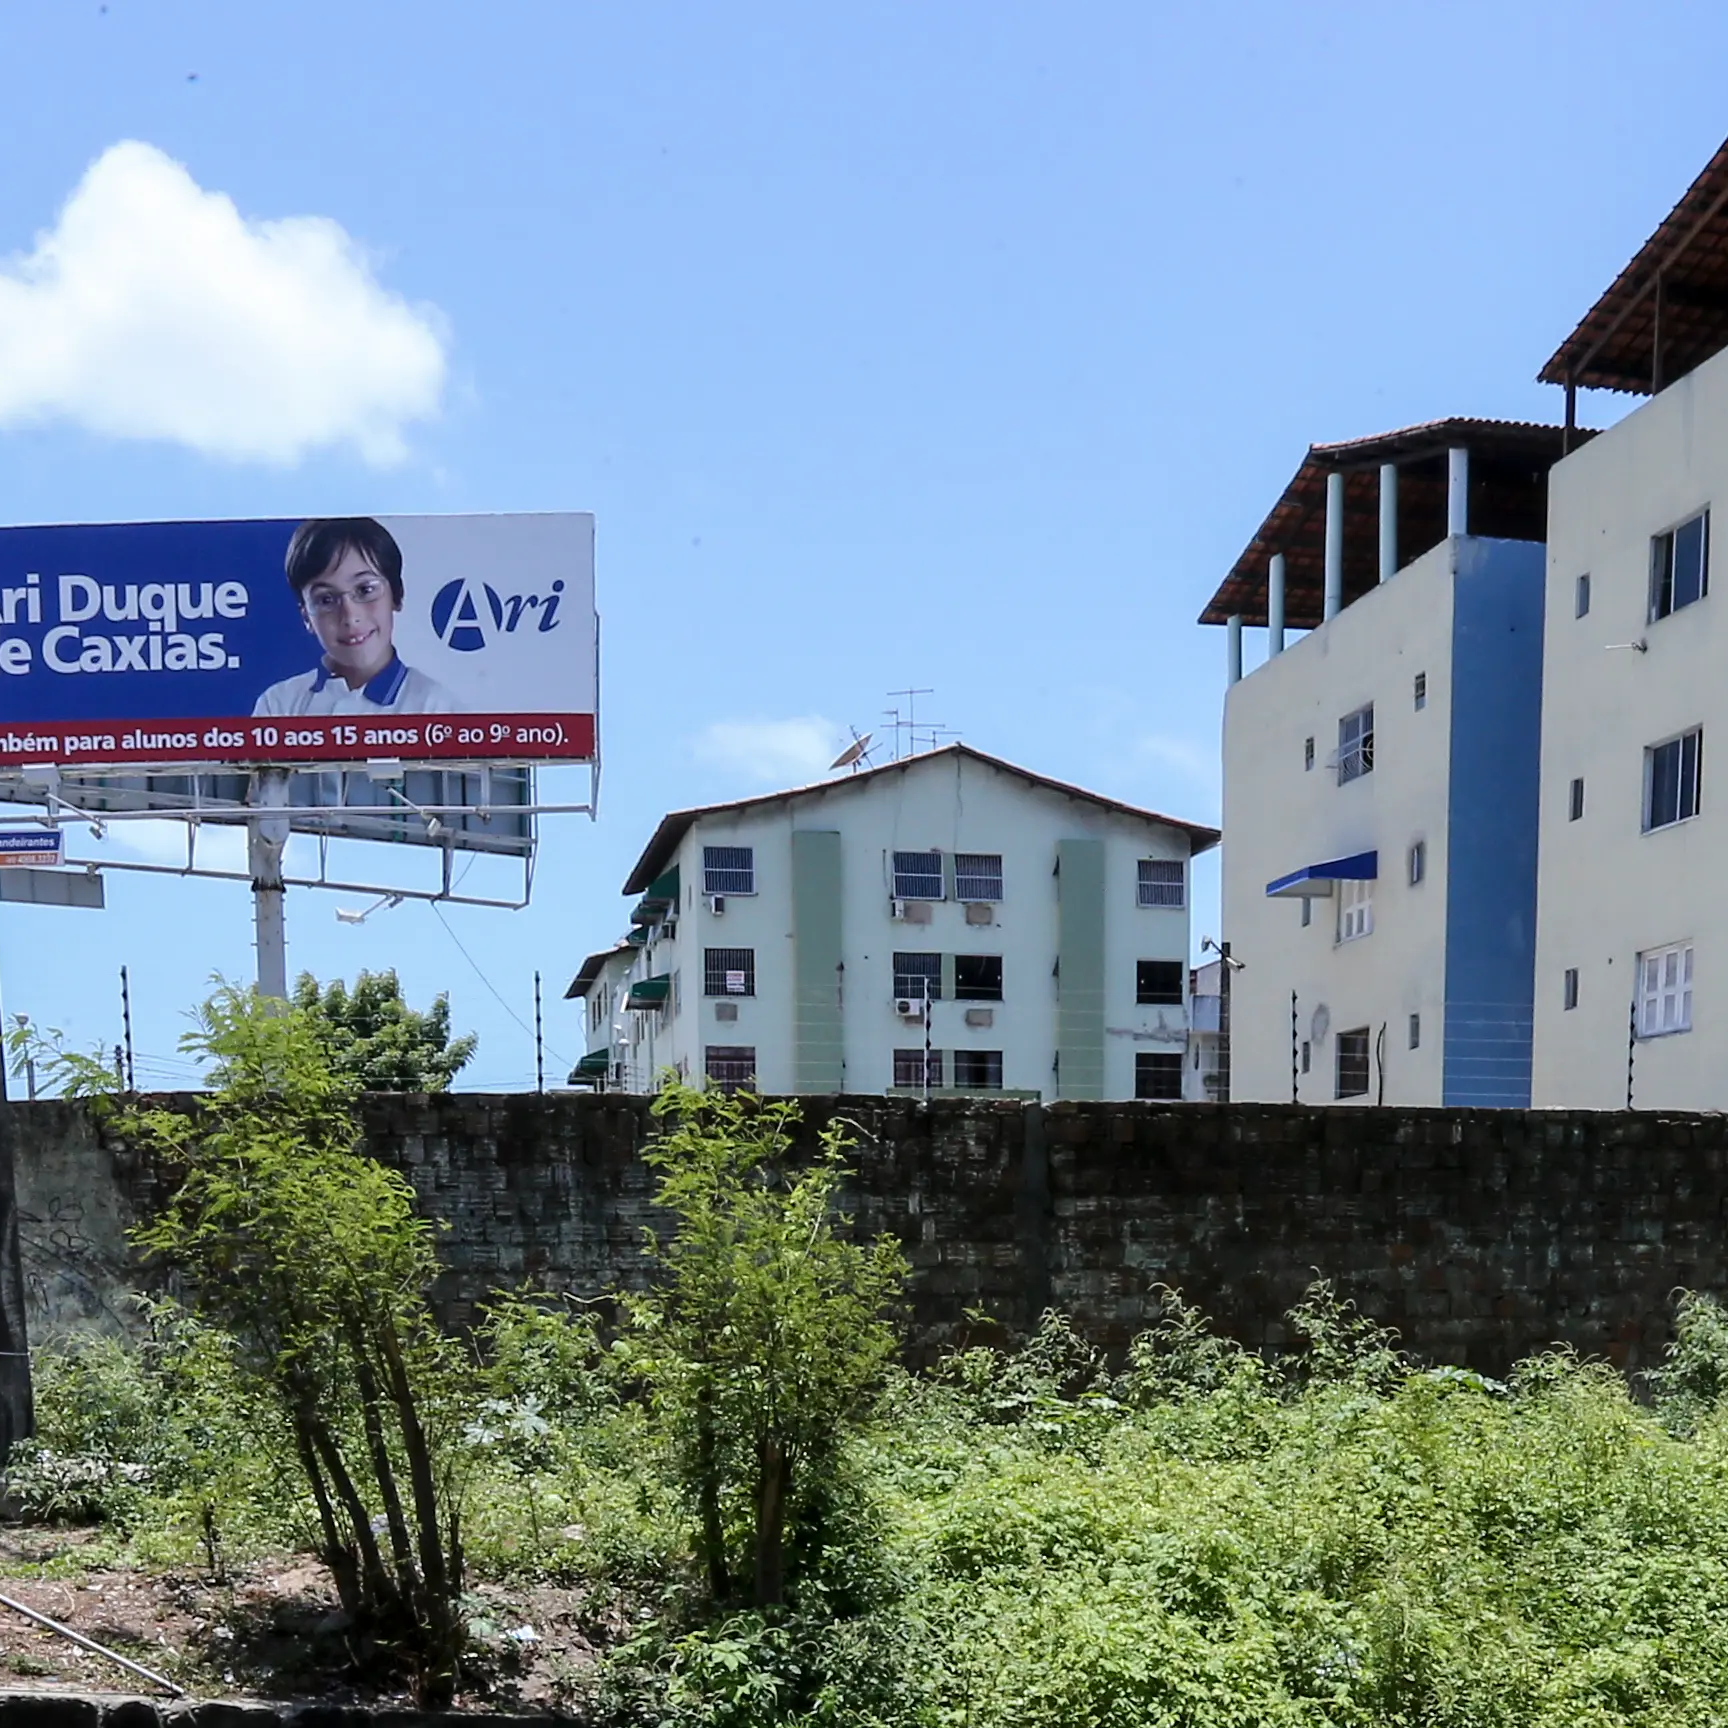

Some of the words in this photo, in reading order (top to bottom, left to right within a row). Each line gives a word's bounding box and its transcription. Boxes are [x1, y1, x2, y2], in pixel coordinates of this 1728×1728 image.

[58, 574, 249, 633] Duque
[431, 578, 565, 652] Ari
[42, 621, 240, 674] Caxias.
[65, 733, 115, 754] para
[122, 729, 197, 749] alunos
[203, 727, 244, 747] dos
[251, 727, 278, 747] 10
[283, 728, 324, 746] aos
[331, 725, 358, 746] 15
[363, 726, 418, 745] anos
[458, 726, 484, 744] ao
[516, 722, 569, 745] ano).
